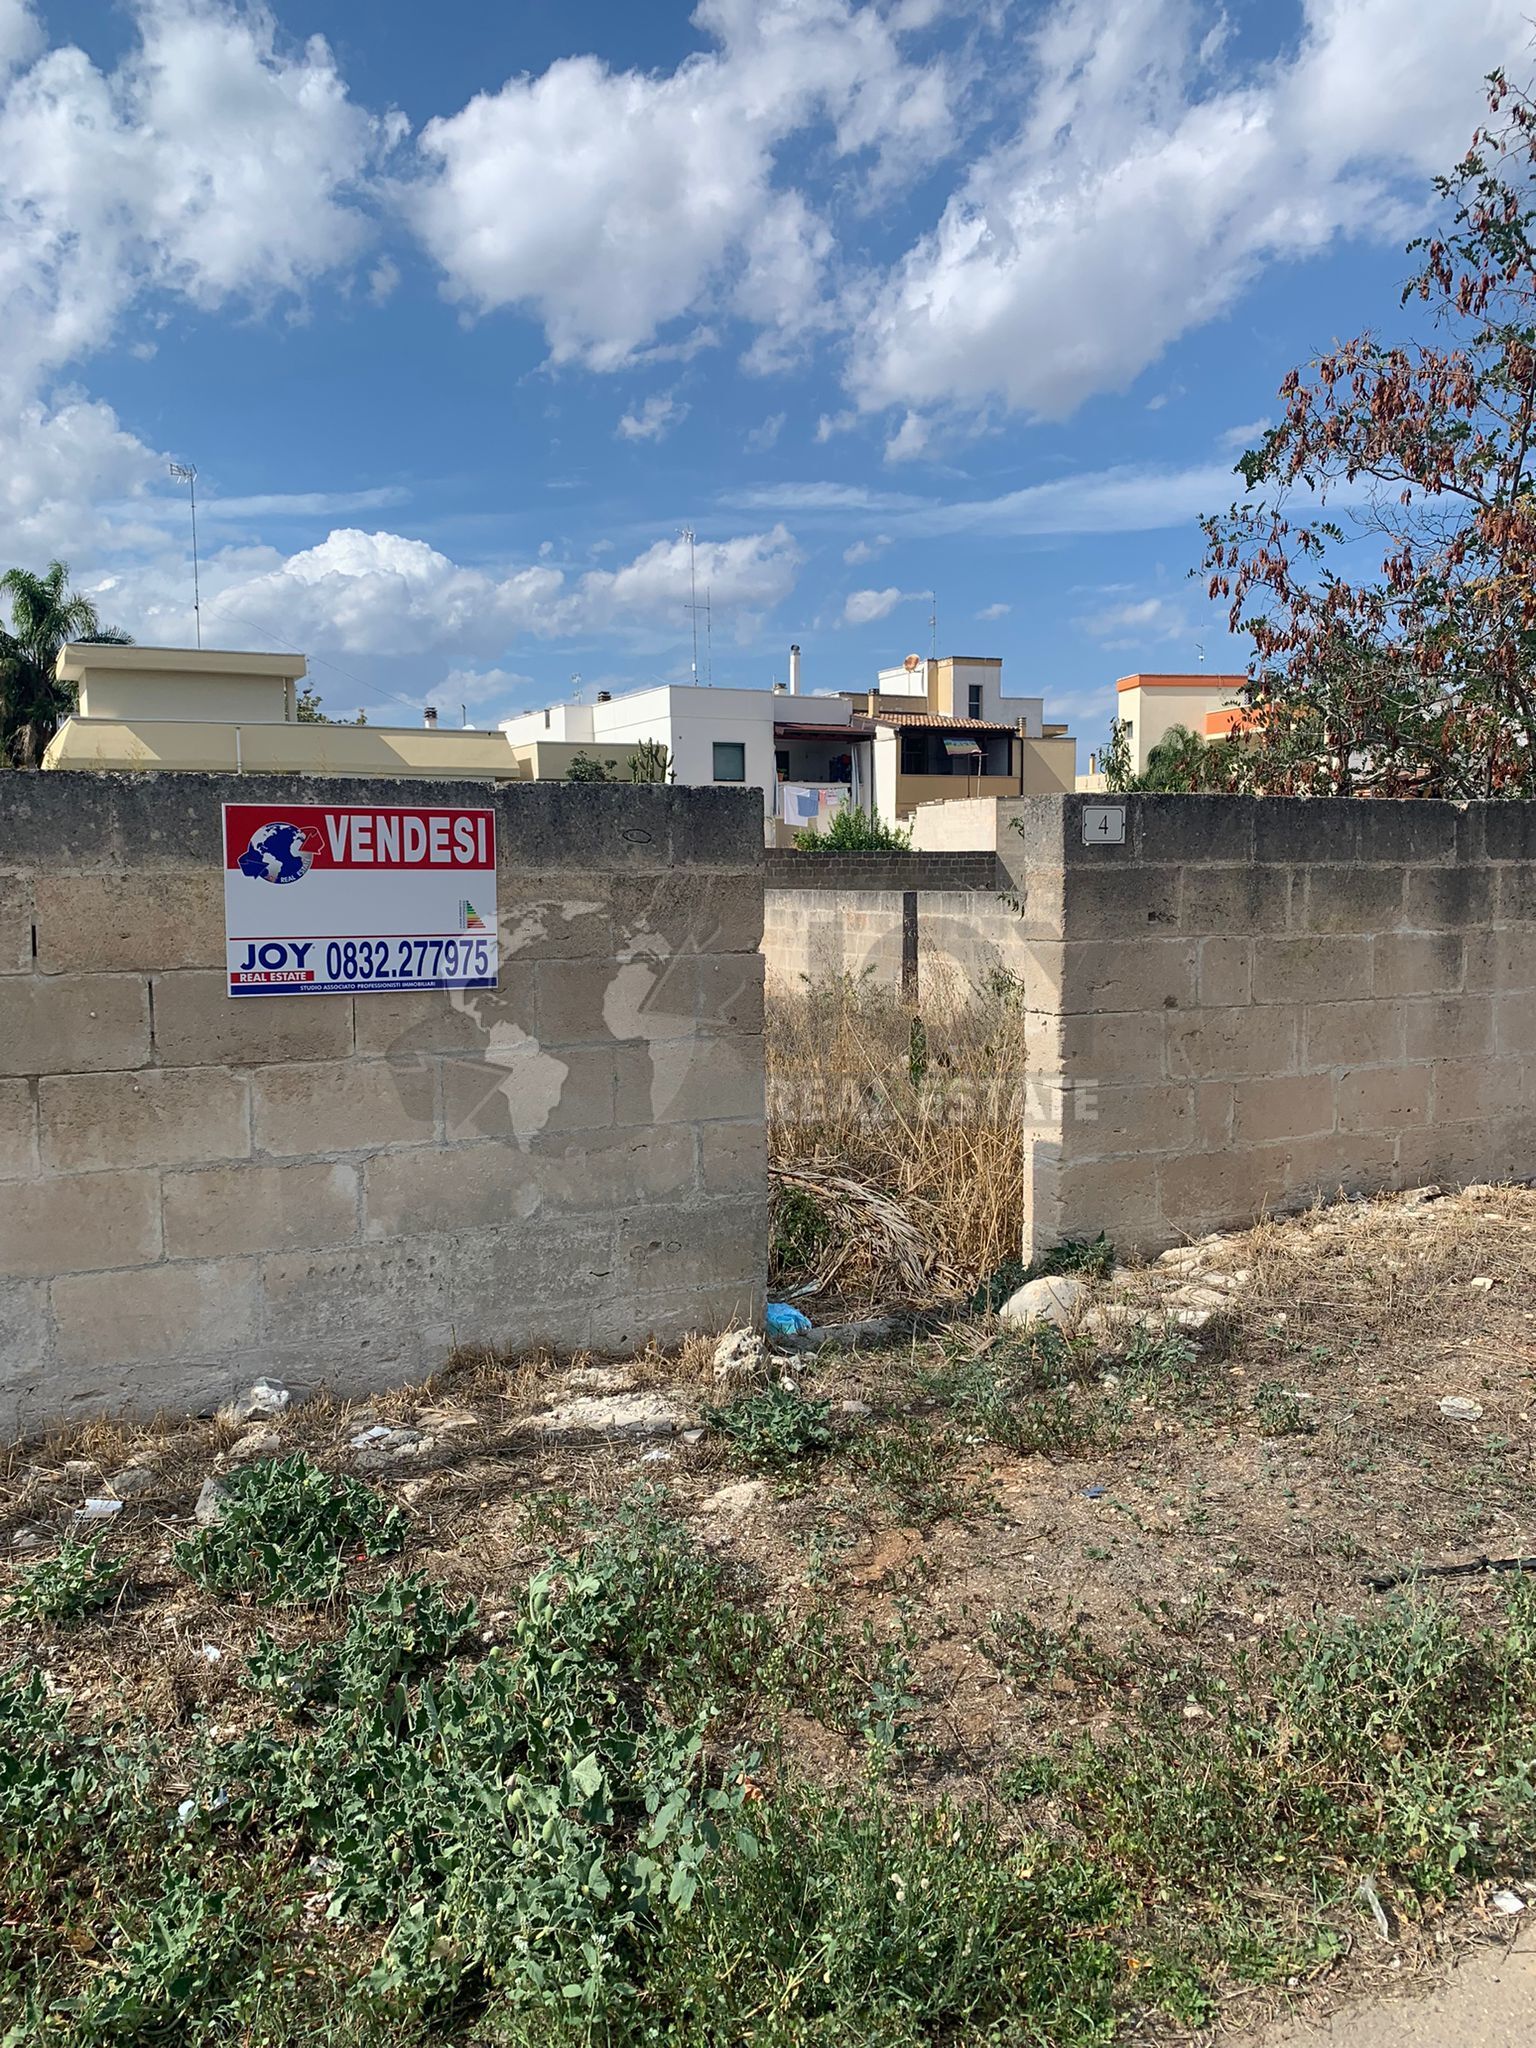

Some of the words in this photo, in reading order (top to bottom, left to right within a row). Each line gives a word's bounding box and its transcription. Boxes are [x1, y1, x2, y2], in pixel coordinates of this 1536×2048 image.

[325, 814, 487, 863] VENDESI
[1098, 815, 1109, 835] 4
[240, 943, 313, 970] JOY
[326, 939, 489, 980] 0832.277975
[240, 972, 267, 982] REAL
[270, 971, 307, 981] ESTATE
